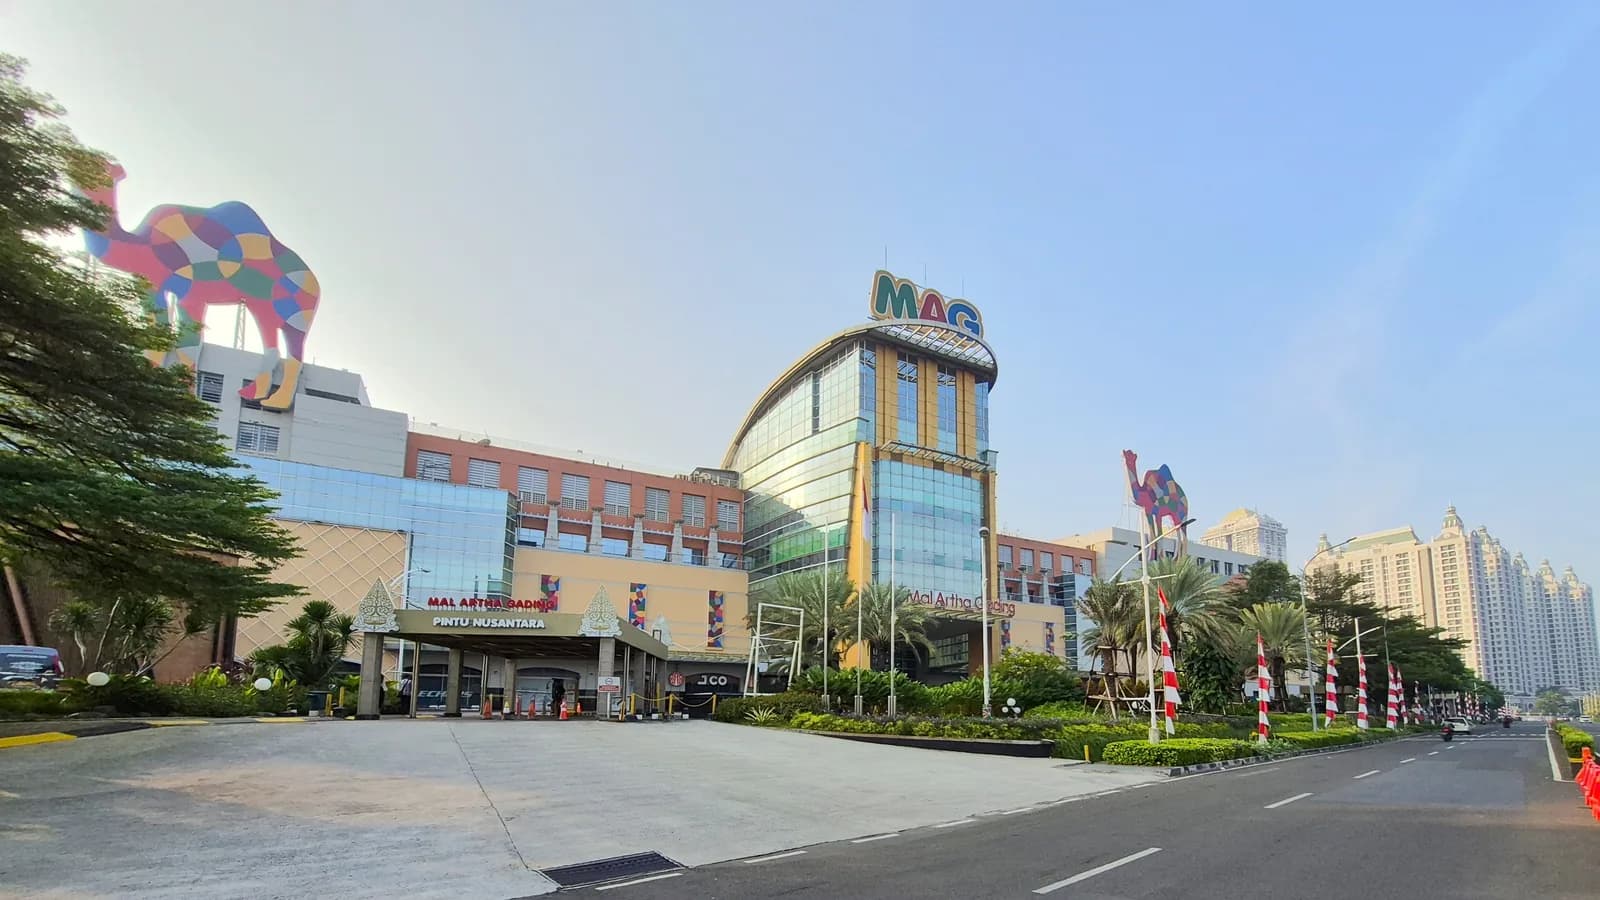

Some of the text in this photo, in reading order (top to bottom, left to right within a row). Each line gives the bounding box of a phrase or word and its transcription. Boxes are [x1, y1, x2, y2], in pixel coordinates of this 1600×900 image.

[871, 270, 984, 338] MAG
[428, 597, 555, 609] MAL ARTHA GADING
[907, 590, 933, 604] Mal
[936, 592, 971, 609] Artha
[433, 617, 545, 629] PINTU NUSANTARA
